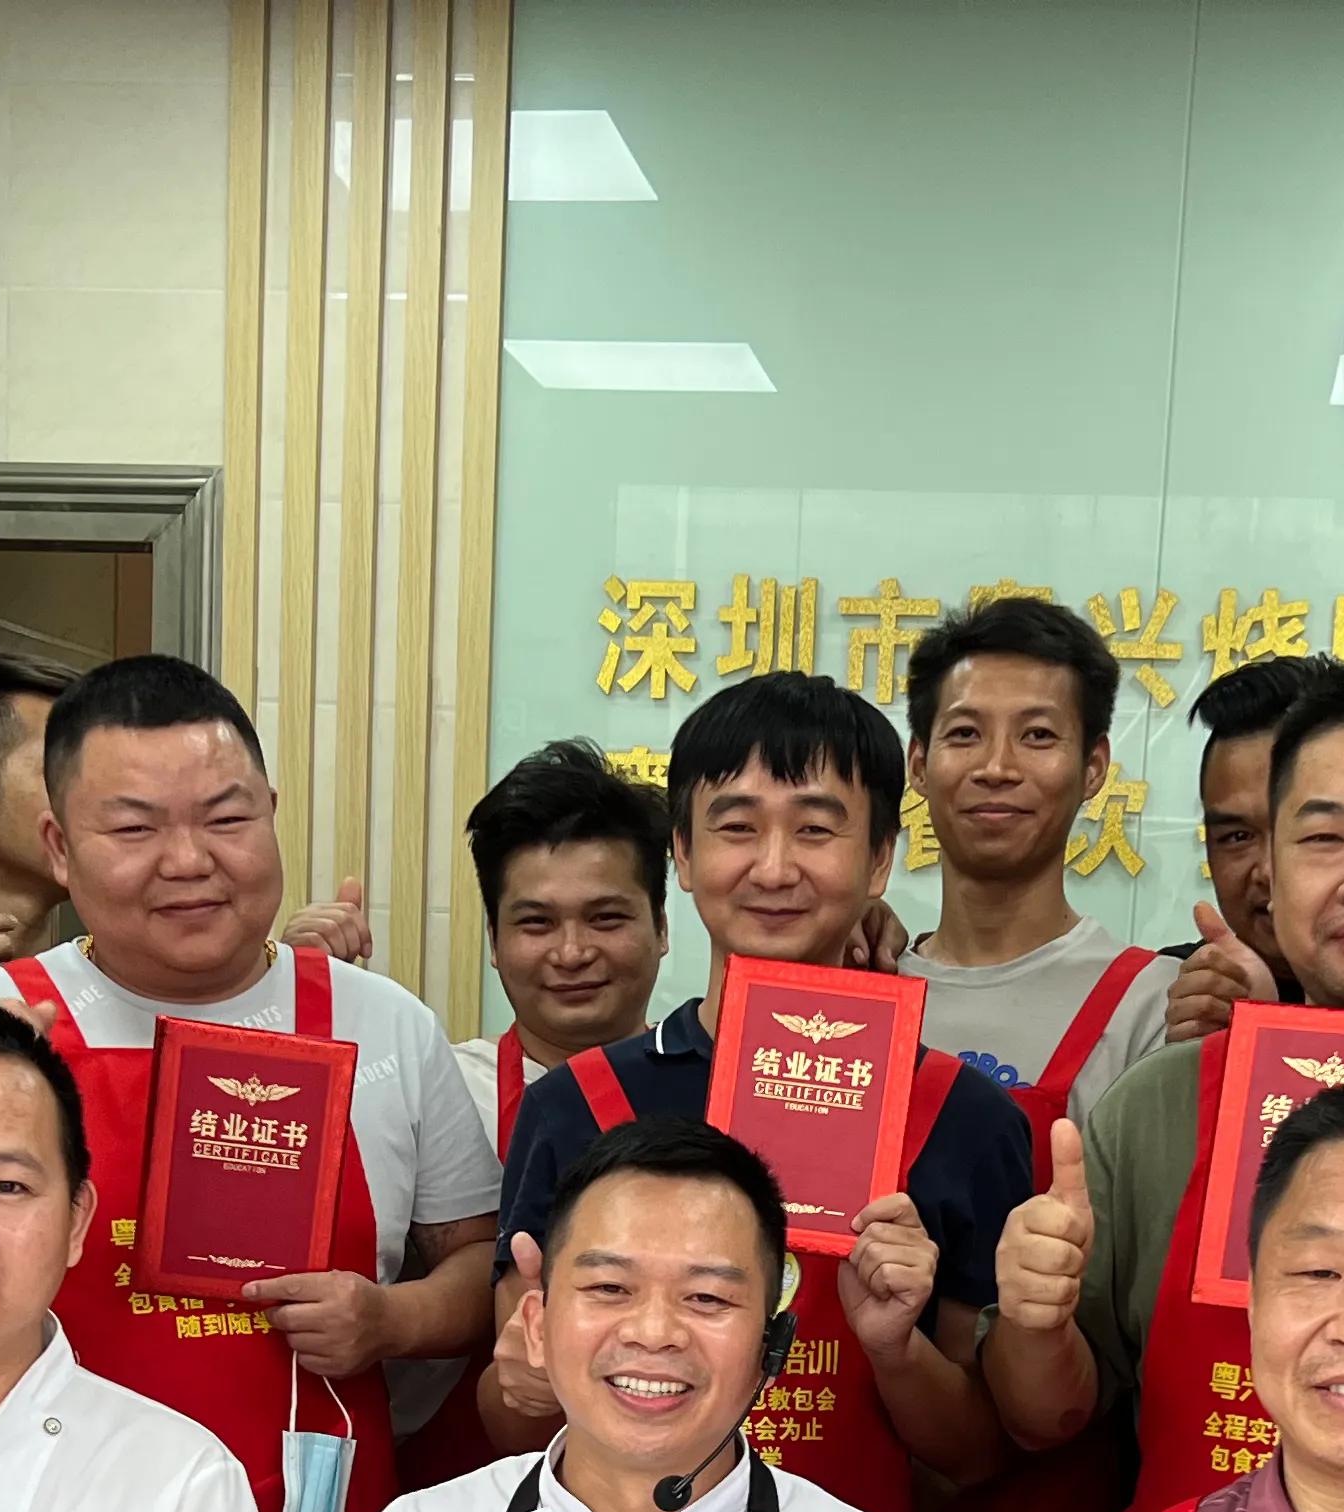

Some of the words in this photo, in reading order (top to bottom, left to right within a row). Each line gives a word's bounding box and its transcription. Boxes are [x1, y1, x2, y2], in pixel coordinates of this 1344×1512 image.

[751, 1047, 873, 1087] 结业证书
[754, 1081, 865, 1107] CERTIFICATE
[189, 1109, 309, 1149] 结业证书
[192, 1142, 301, 1168] CERTIFICATE
